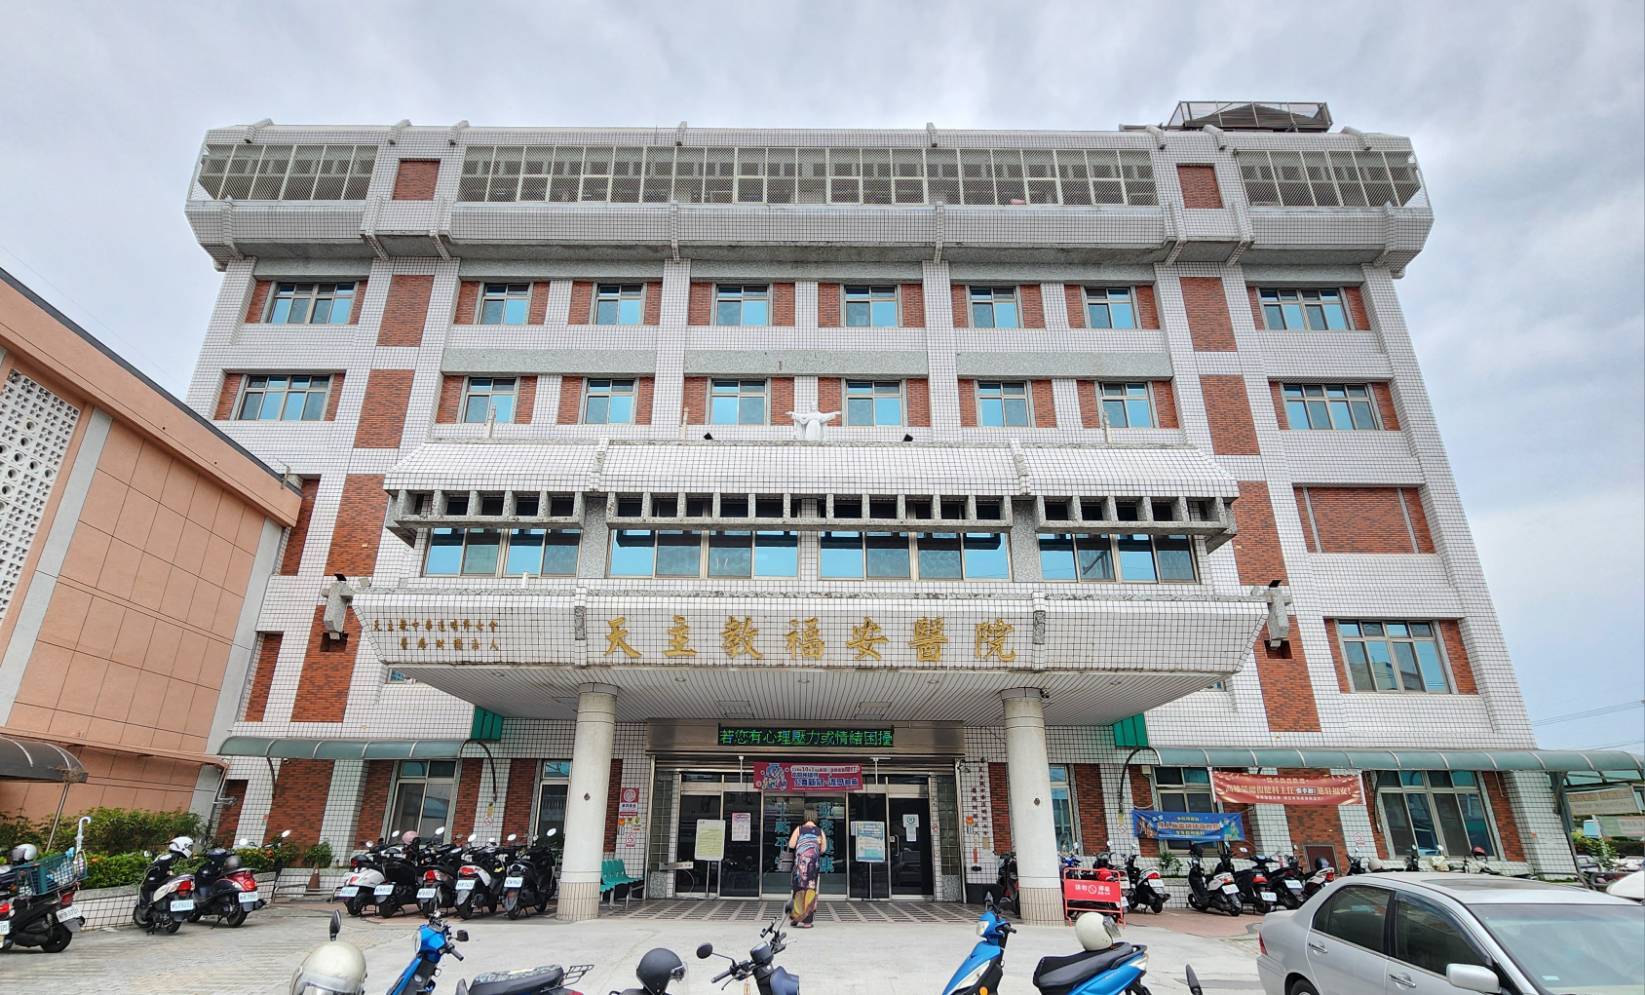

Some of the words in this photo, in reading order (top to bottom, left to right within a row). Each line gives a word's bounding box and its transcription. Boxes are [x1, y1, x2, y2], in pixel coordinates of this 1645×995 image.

[603, 615, 1017, 662] 天主教福安醫院
